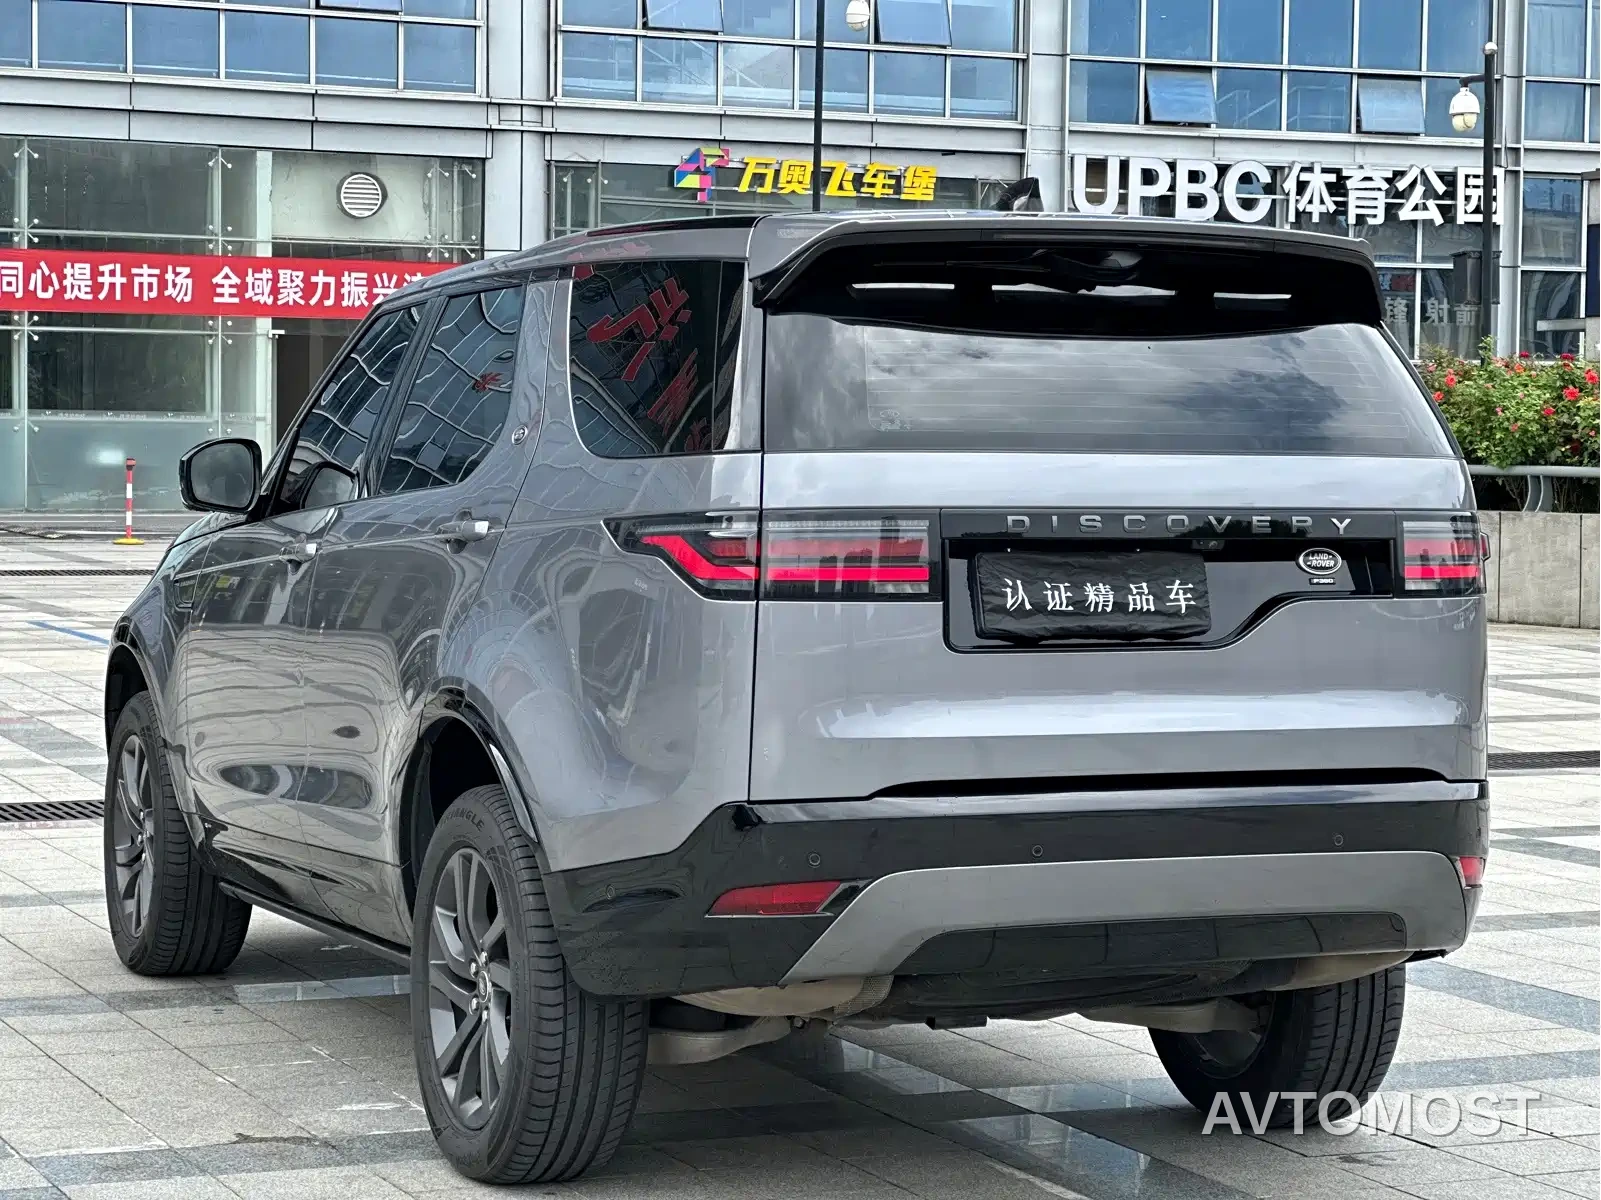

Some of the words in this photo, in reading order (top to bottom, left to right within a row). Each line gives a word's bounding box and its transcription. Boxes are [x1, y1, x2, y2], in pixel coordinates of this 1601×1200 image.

[737, 155, 939, 201] 万奥飞车堡
[1072, 153, 1273, 223] UPBC
[1281, 160, 1505, 227] 体育公园
[0, 260, 193, 304] 同心提升市场
[1006, 514, 1353, 536] DISCOVERY
[1001, 577, 1197, 615] 认证精品车
